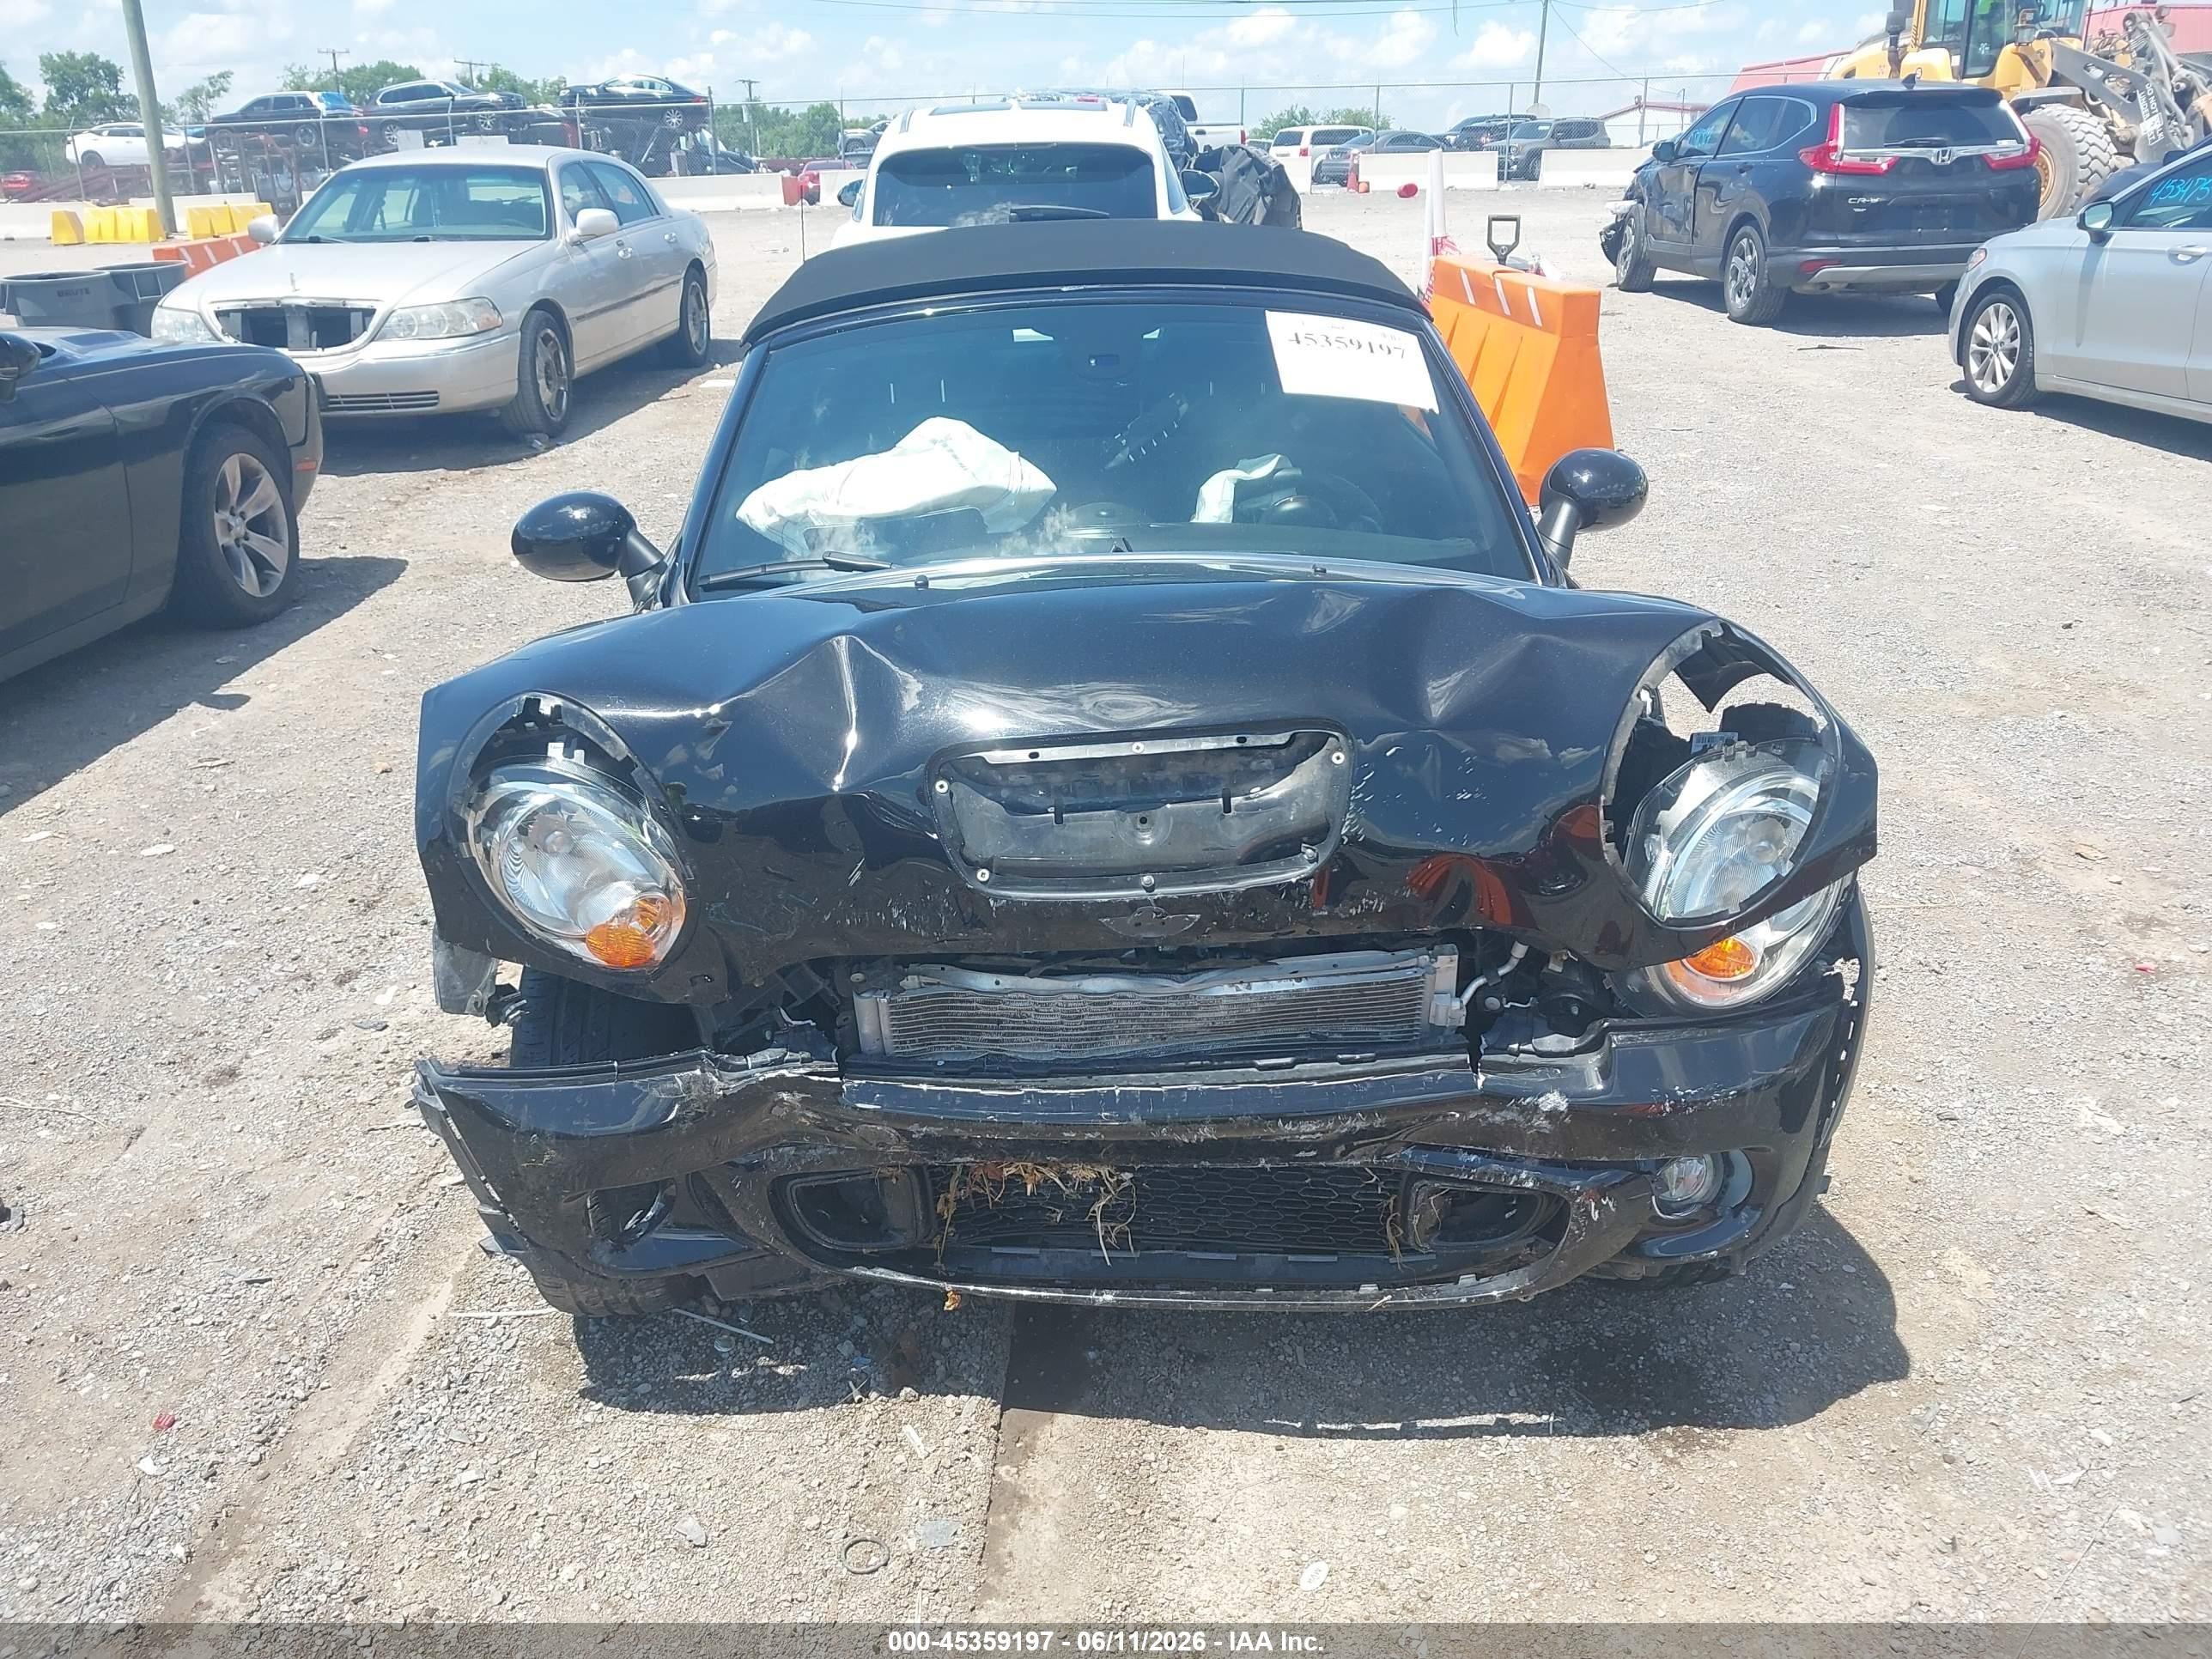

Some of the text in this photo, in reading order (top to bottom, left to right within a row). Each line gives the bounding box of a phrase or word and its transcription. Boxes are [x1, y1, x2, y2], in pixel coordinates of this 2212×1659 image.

[2145, 82, 2154, 96] DO
[2139, 90, 2150, 121] UNDER
[2148, 95, 2159, 114] NOT
[1288, 332, 1405, 359] 45359197
